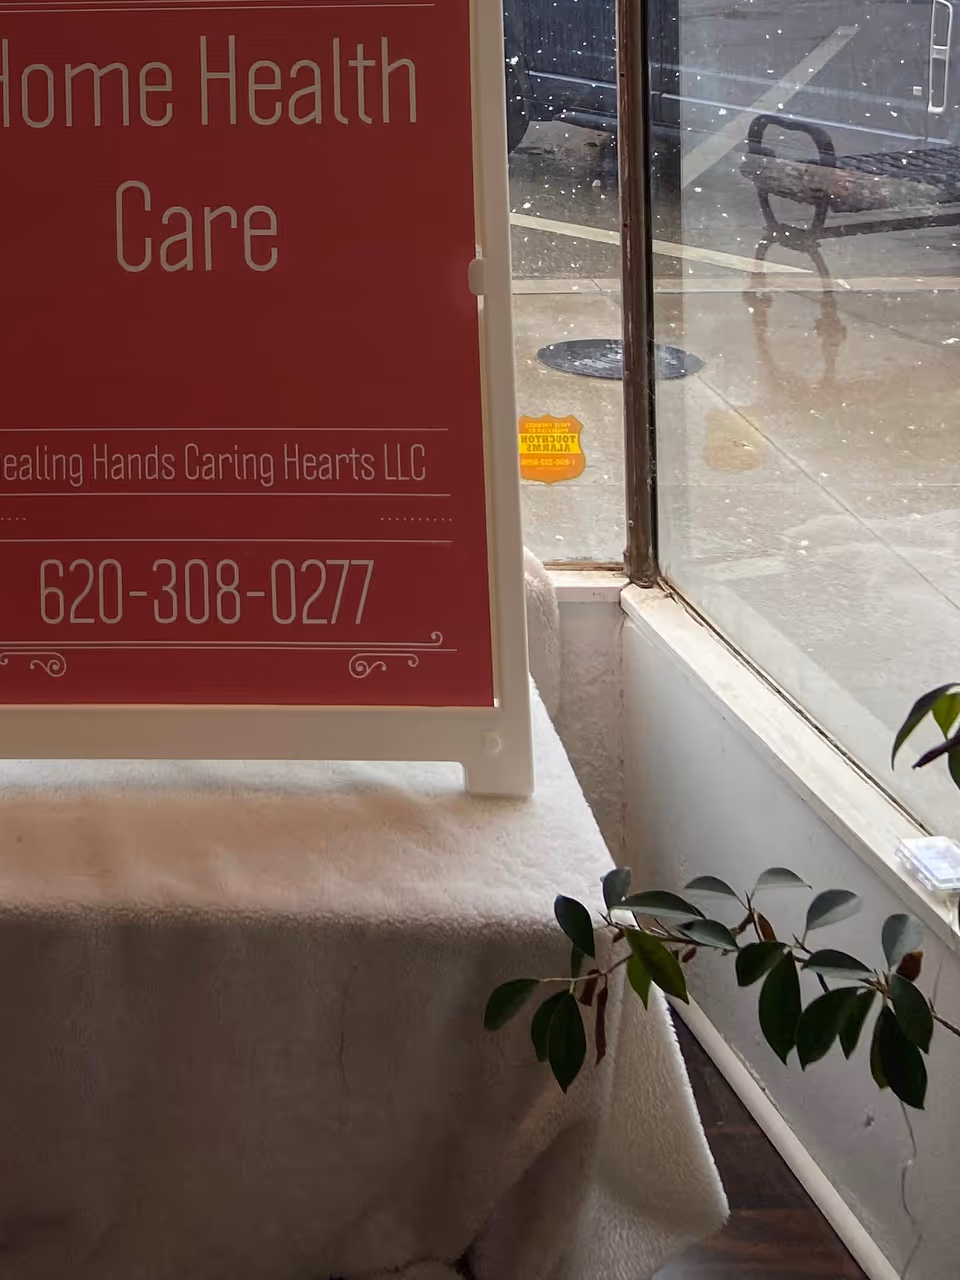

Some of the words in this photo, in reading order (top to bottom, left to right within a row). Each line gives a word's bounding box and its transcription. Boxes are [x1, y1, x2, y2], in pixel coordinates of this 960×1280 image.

[200, 34, 417, 126] Health
[116, 179, 279, 272] Care
[93, 443, 175, 481] Hands
[184, 443, 275, 487] Caring
[284, 443, 375, 481] Hearts
[384, 443, 426, 481] LLC
[39, 558, 375, 625] 620-308-0277
